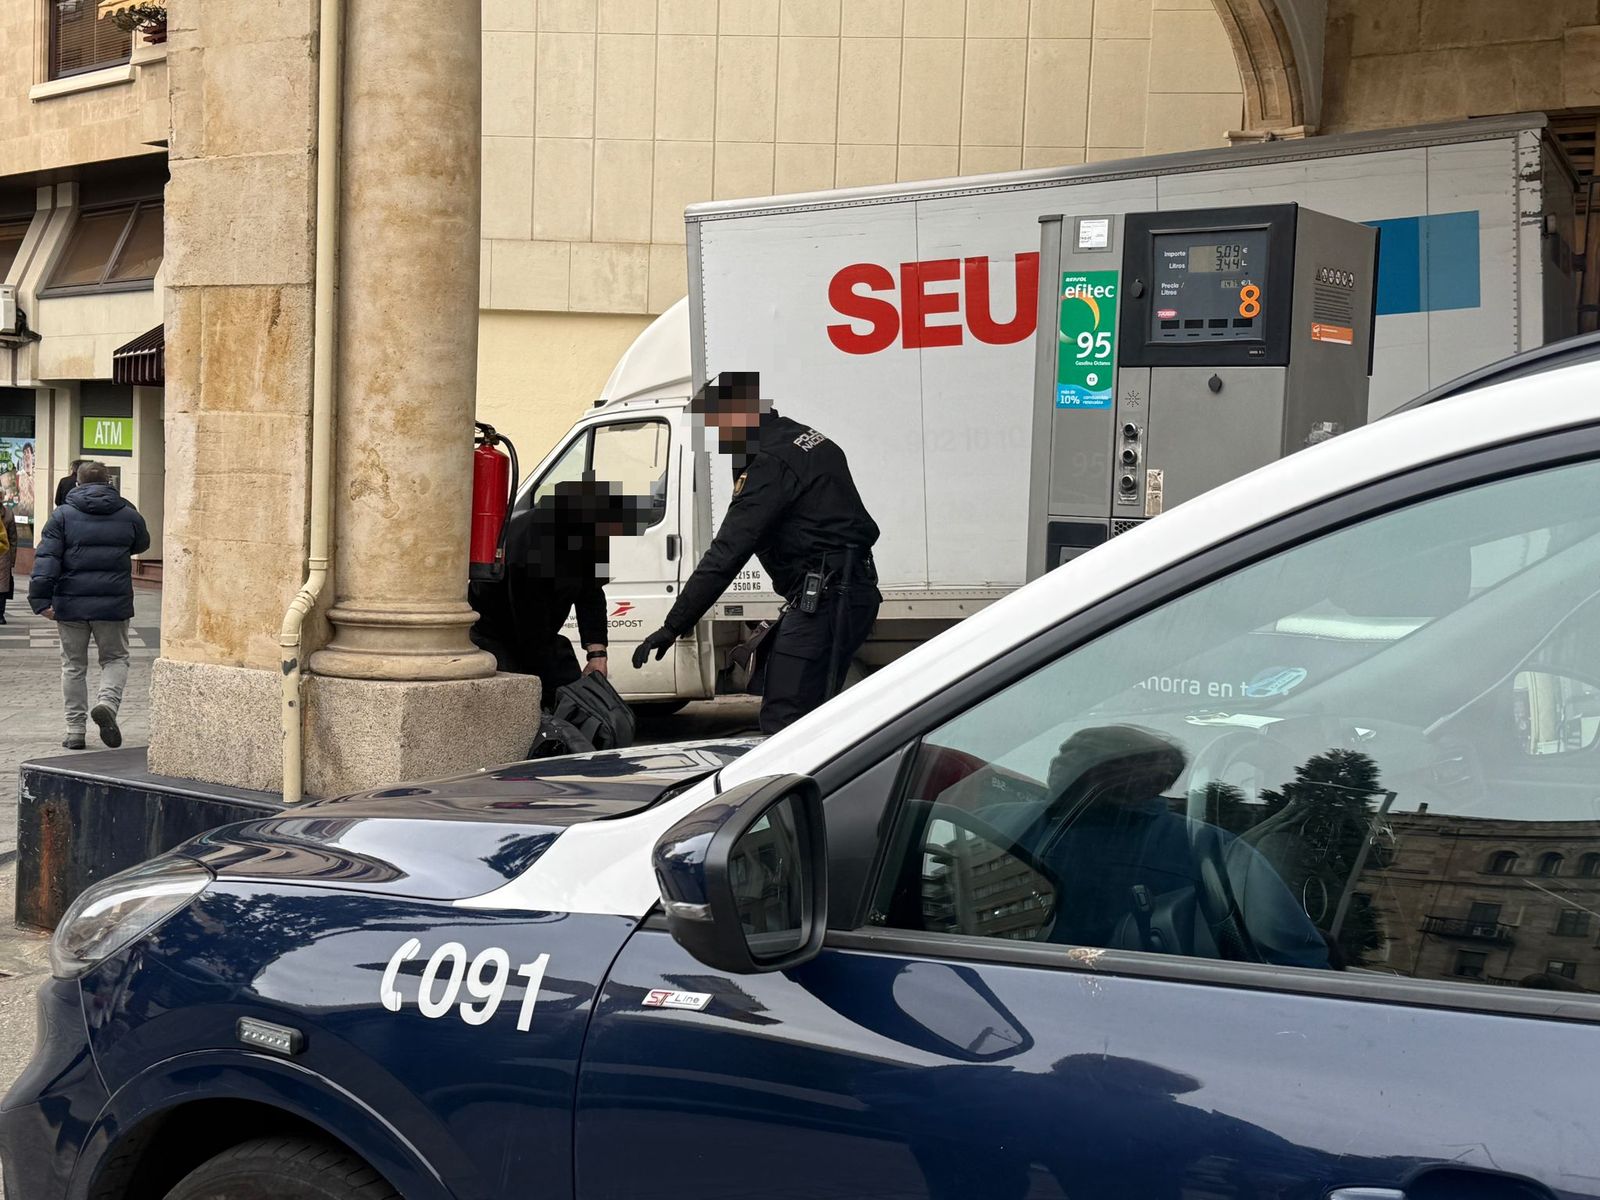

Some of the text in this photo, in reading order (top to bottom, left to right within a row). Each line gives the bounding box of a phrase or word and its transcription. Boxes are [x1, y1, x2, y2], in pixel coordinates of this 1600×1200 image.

[1216, 245, 1240, 259] 5.09
[1065, 283, 1115, 298] efitec
[827, 252, 1040, 355] SEU
[1239, 284, 1261, 319] 8
[1076, 331, 1112, 359] 95
[1060, 395, 1080, 405] 10%
[94, 421, 122, 446] ATM
[735, 570, 761, 580] 215 KG
[733, 582, 761, 591] 3500 KG
[1207, 681, 1233, 698] en
[417, 941, 550, 1032] 091
[674, 995, 699, 1004] Line
